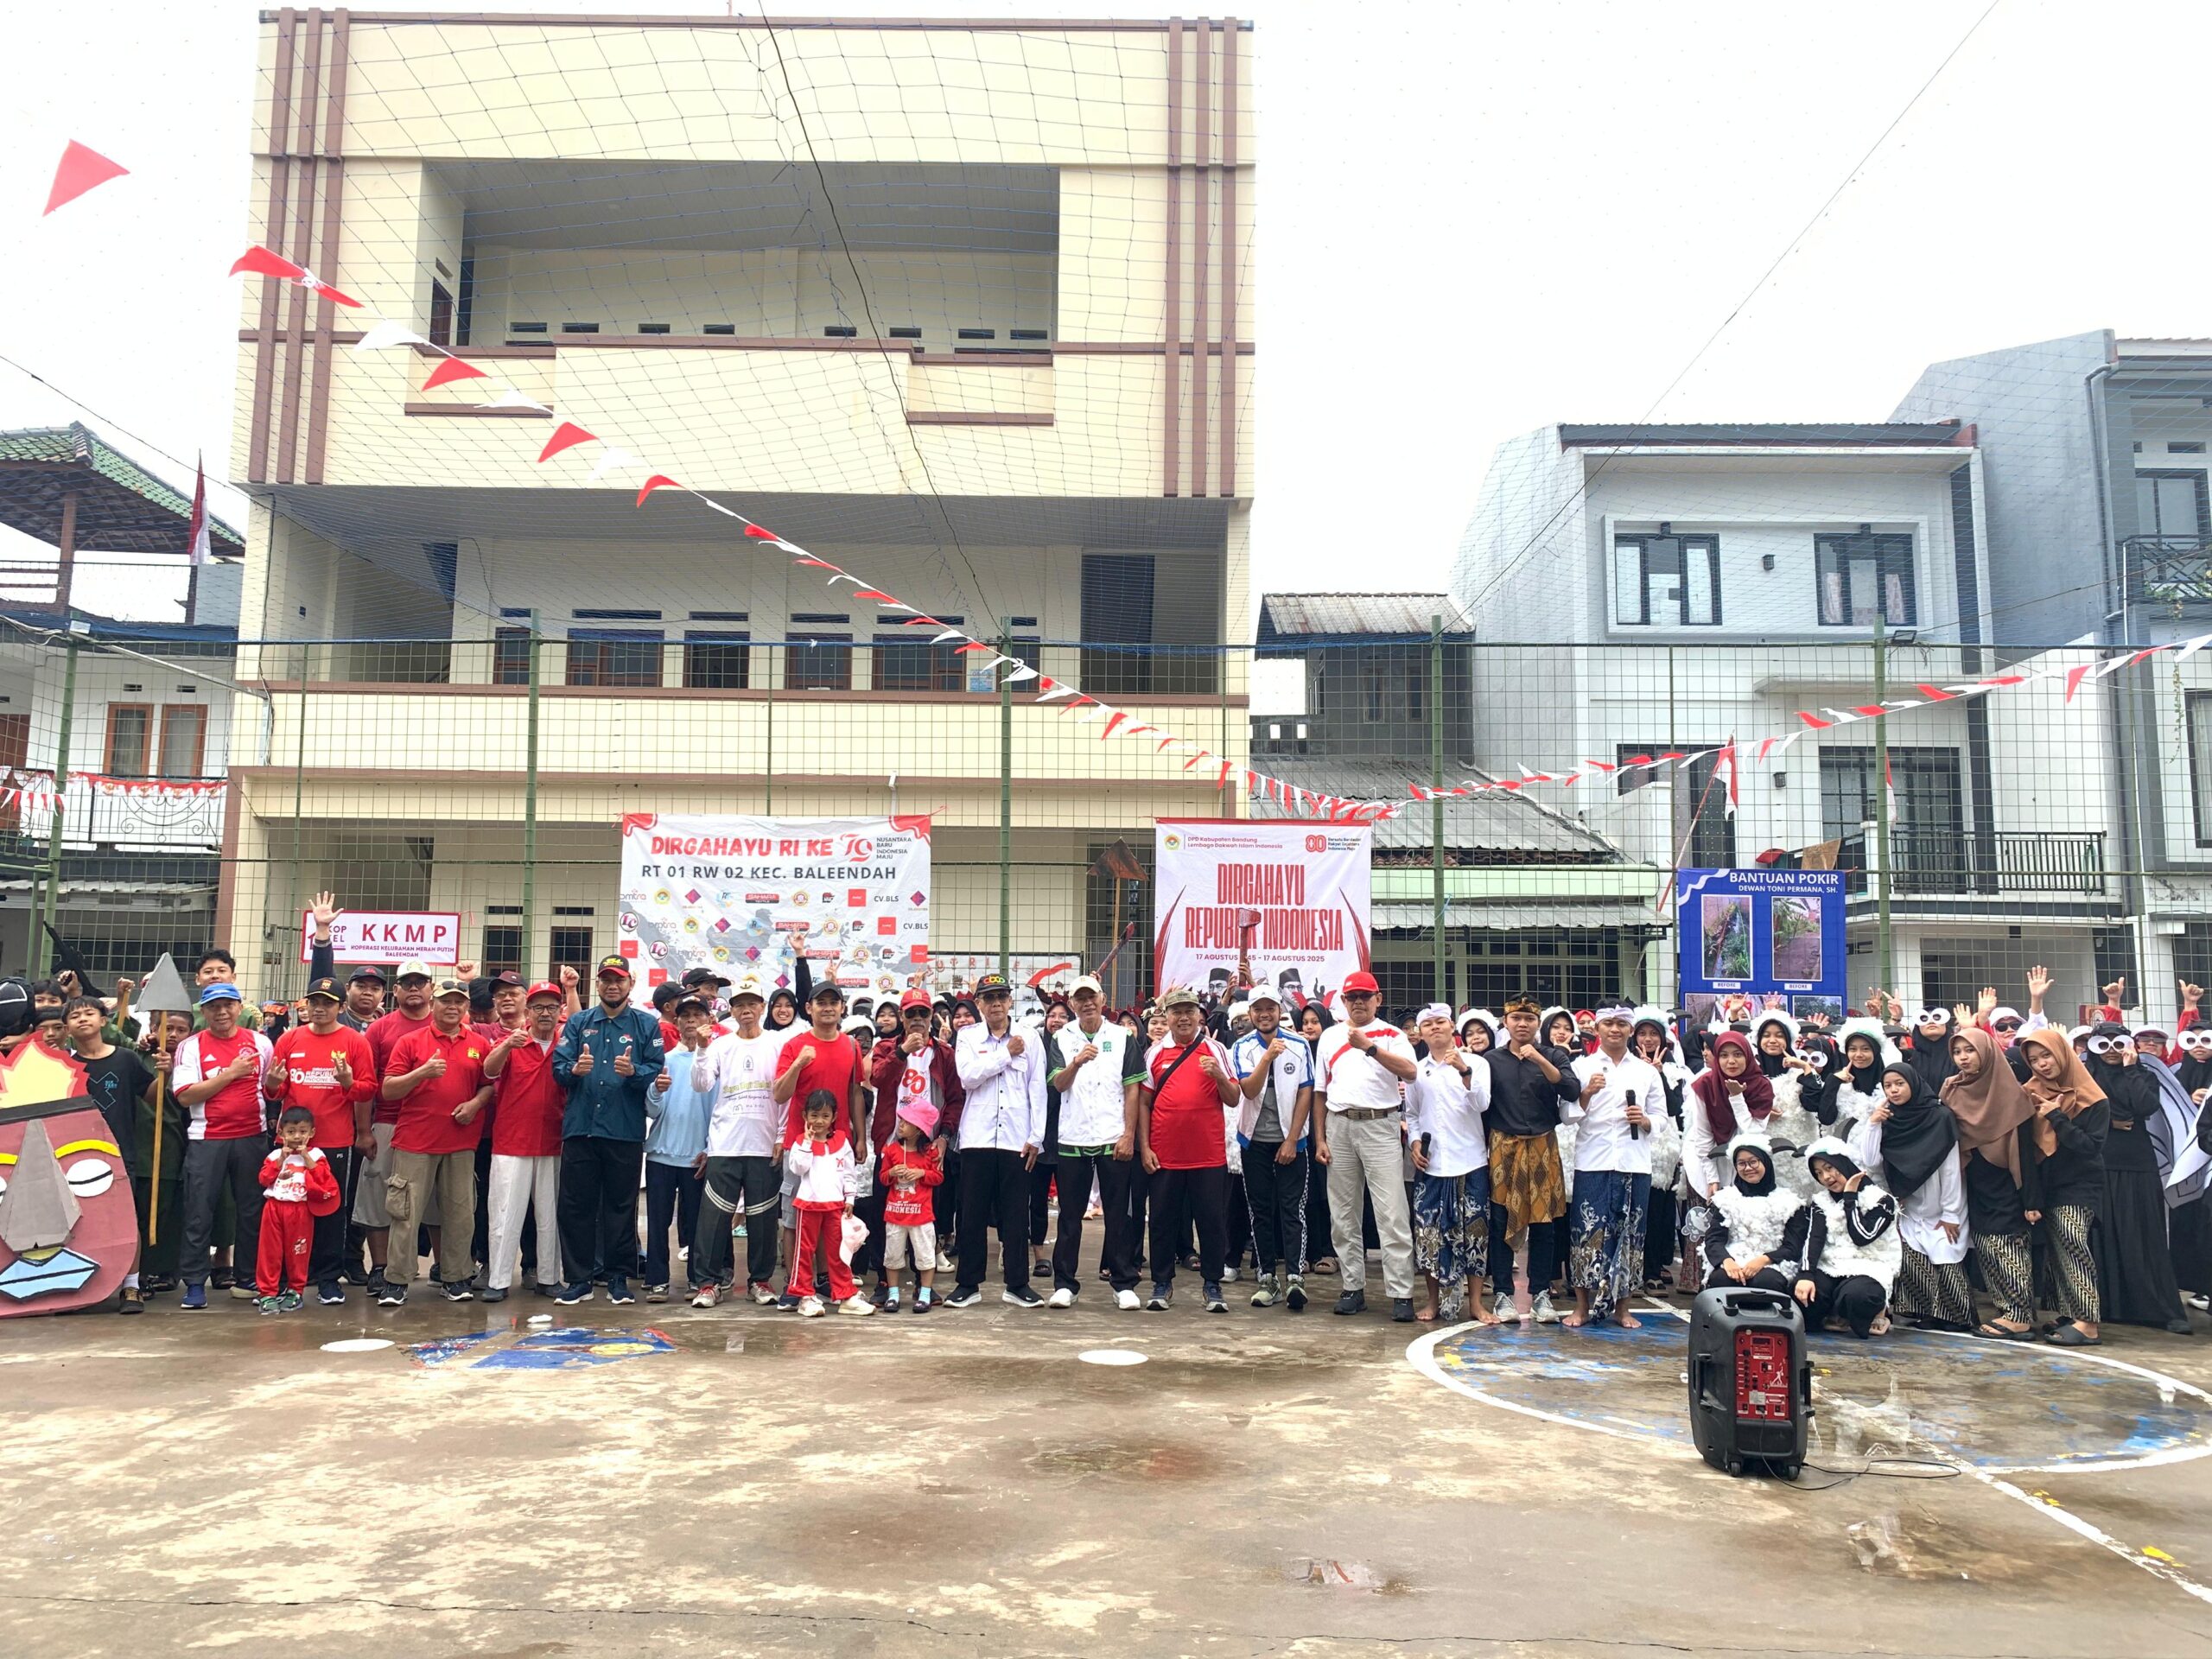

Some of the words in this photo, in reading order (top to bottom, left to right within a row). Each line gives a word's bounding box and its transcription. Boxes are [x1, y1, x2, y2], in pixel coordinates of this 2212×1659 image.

[651, 836, 772, 856] DIRGAHAYU
[779, 839, 799, 856] RI
[806, 838, 834, 856] KE
[642, 865, 661, 878] RT
[667, 866, 685, 878] 01
[693, 867, 719, 879] RW
[725, 867, 744, 879] 02
[750, 867, 786, 880] KEC.
[794, 867, 896, 880] BALEENDAH
[1730, 873, 1795, 884] BANTUAN
[1799, 874, 1839, 885] POKIR
[1217, 863, 1305, 906] DIRGAHAYU
[362, 924, 447, 943] KKMP
[1185, 906, 1257, 950] REPUBLK
[1263, 907, 1344, 950] INDONESIA
[902, 1068, 926, 1095] 80
[886, 1204, 922, 1214] INDONESIA
